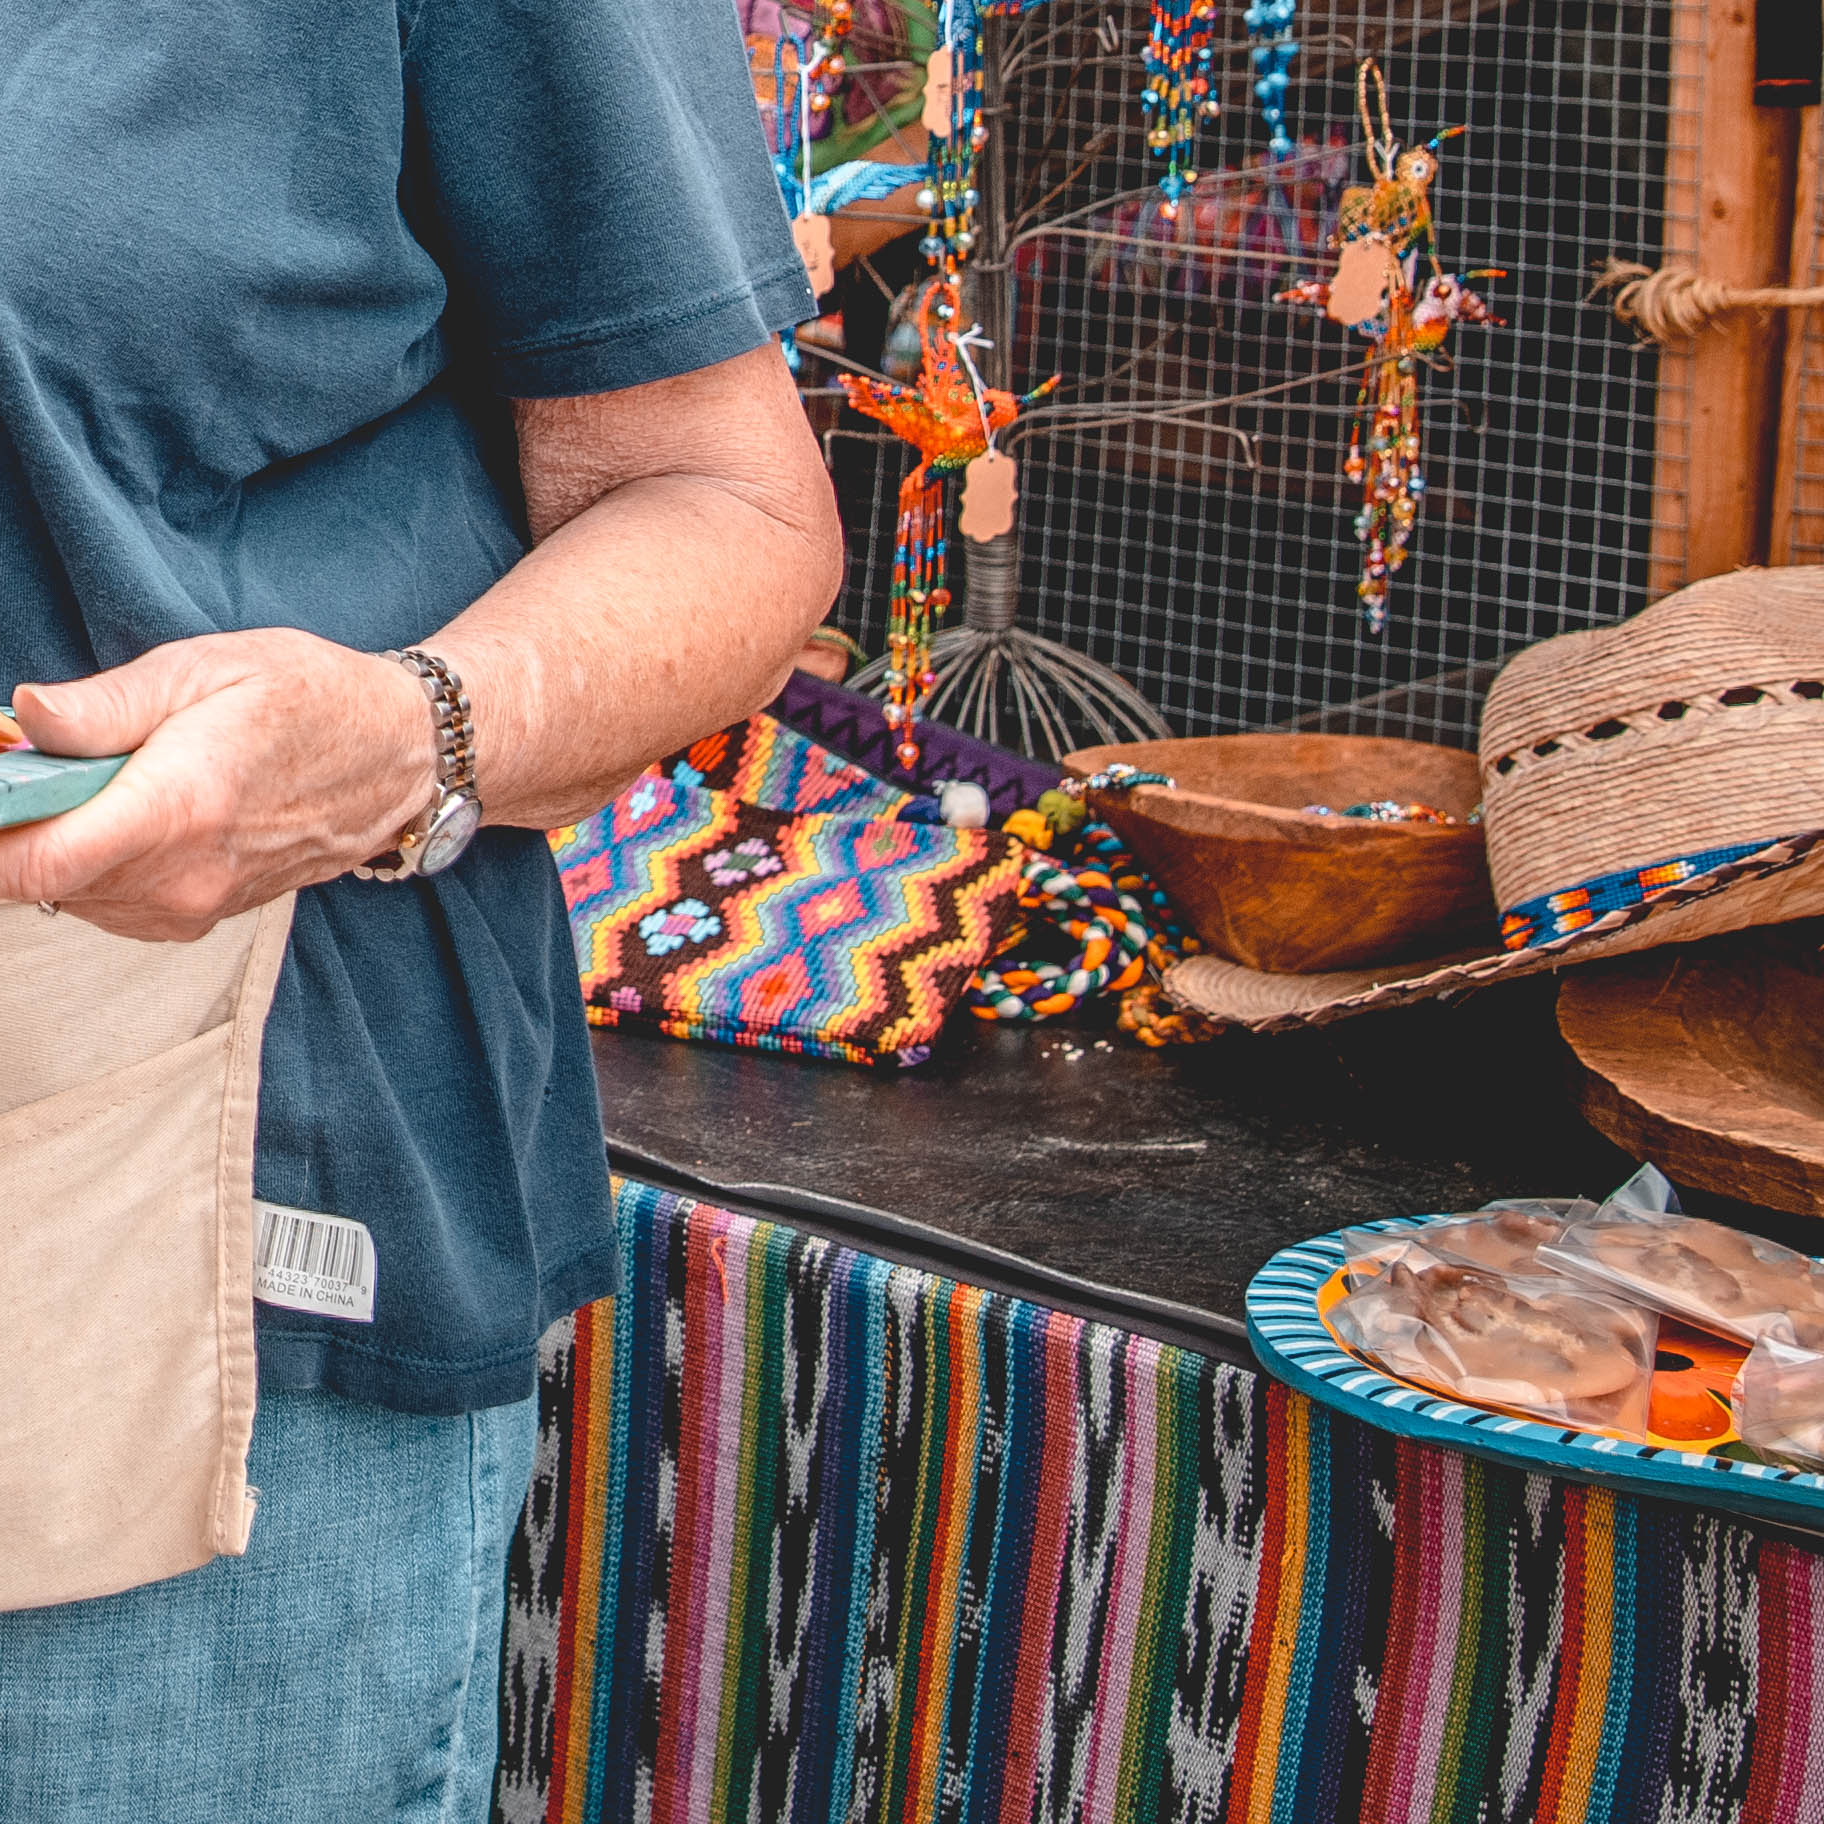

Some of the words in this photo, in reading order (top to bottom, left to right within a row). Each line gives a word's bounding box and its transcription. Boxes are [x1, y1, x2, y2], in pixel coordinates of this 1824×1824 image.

[257, 1276, 296, 1296] MADE
[299, 1287, 313, 1299] IN
[316, 1290, 354, 1307] CHINA
[268, 1268, 308, 1285] 44323
[314, 1277, 347, 1292] 70037
[360, 1286, 367, 1295] 9
